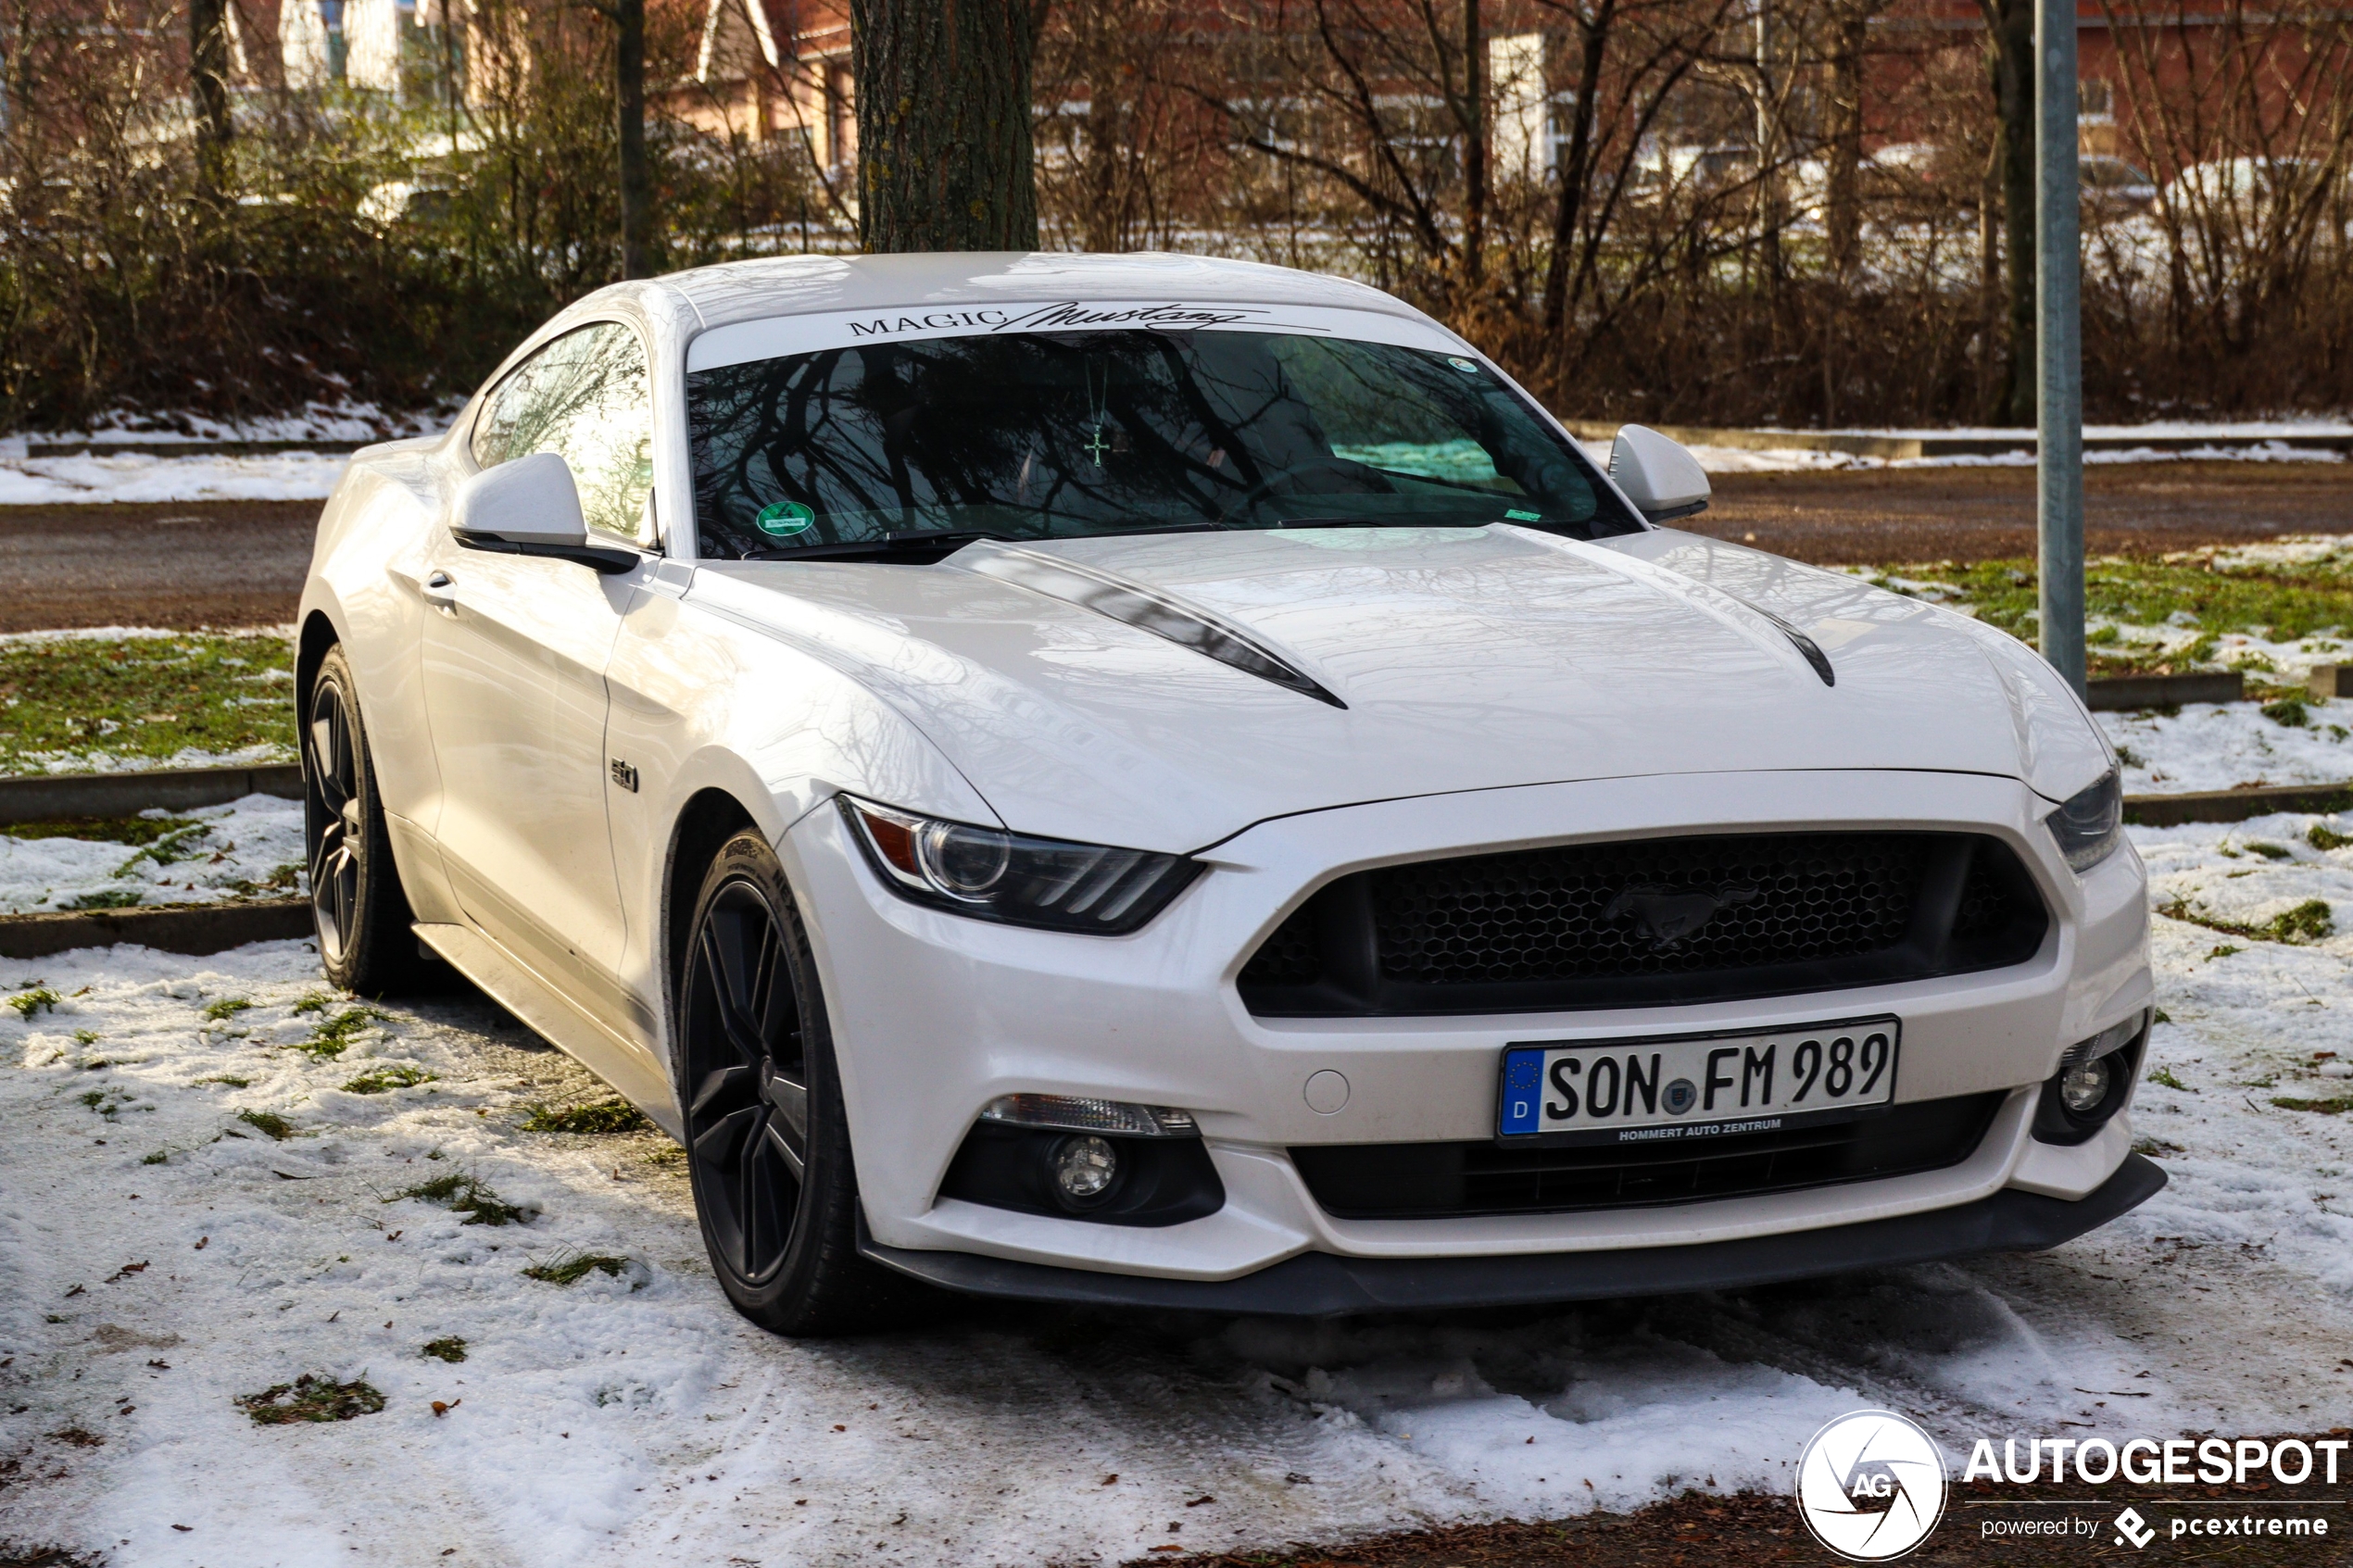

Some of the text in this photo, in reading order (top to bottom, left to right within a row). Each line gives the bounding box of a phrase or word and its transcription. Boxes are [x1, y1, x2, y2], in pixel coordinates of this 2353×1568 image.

[847, 302, 1331, 337] MAGIC Mustang
[1545, 1033, 1890, 1121] SON FM 989
[1513, 1101, 1529, 1119] D
[1618, 1118, 1782, 1141] HOMMERT AUTO ZENTRUM
